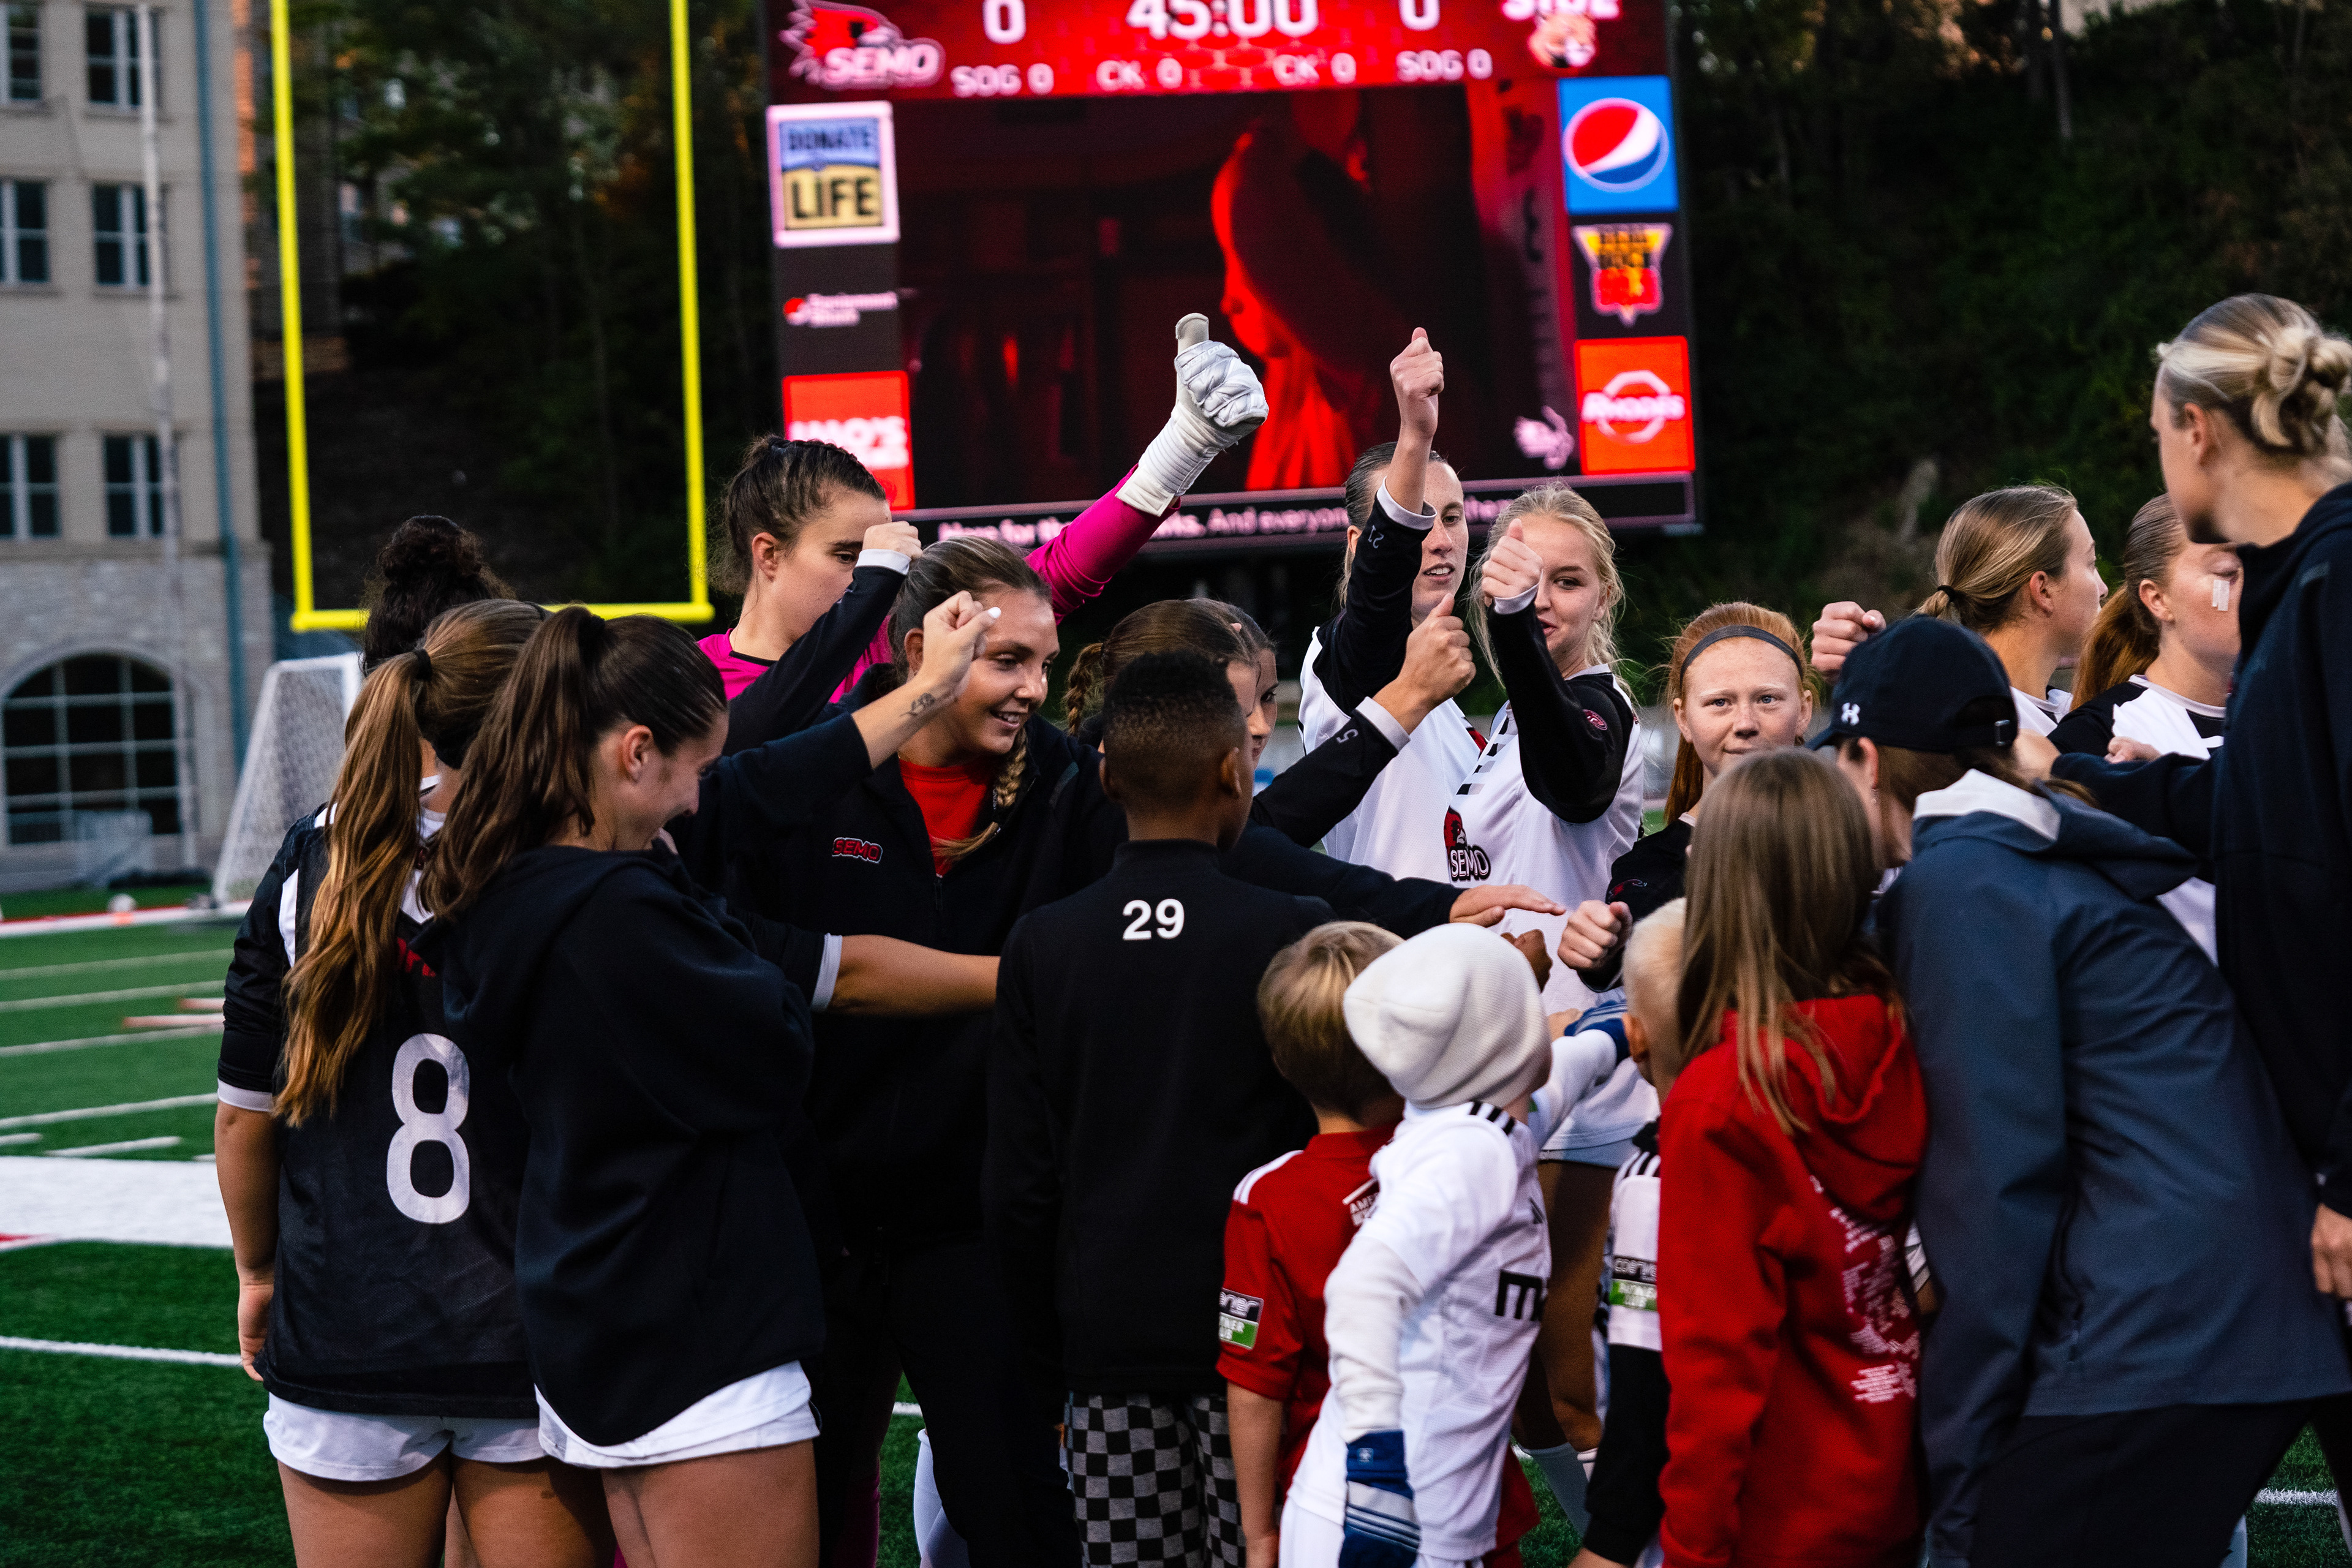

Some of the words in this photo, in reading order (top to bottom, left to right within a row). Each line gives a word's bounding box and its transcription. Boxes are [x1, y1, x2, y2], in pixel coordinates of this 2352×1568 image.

[982, 0, 1025, 43] 0
[1126, 0, 1319, 40] 45:00
[824, 43, 941, 81] SEMO
[1027, 62, 1054, 94] 0
[1156, 58, 1183, 89] 0
[1330, 53, 1357, 82] 0
[1468, 48, 1493, 80] 0
[791, 177, 873, 219] LIFE
[1257, 506, 1350, 537] everyon
[832, 837, 883, 864] SEMO
[1450, 848, 1490, 878] SEMO
[1122, 898, 1185, 941] 29
[386, 1033, 470, 1224] 8
